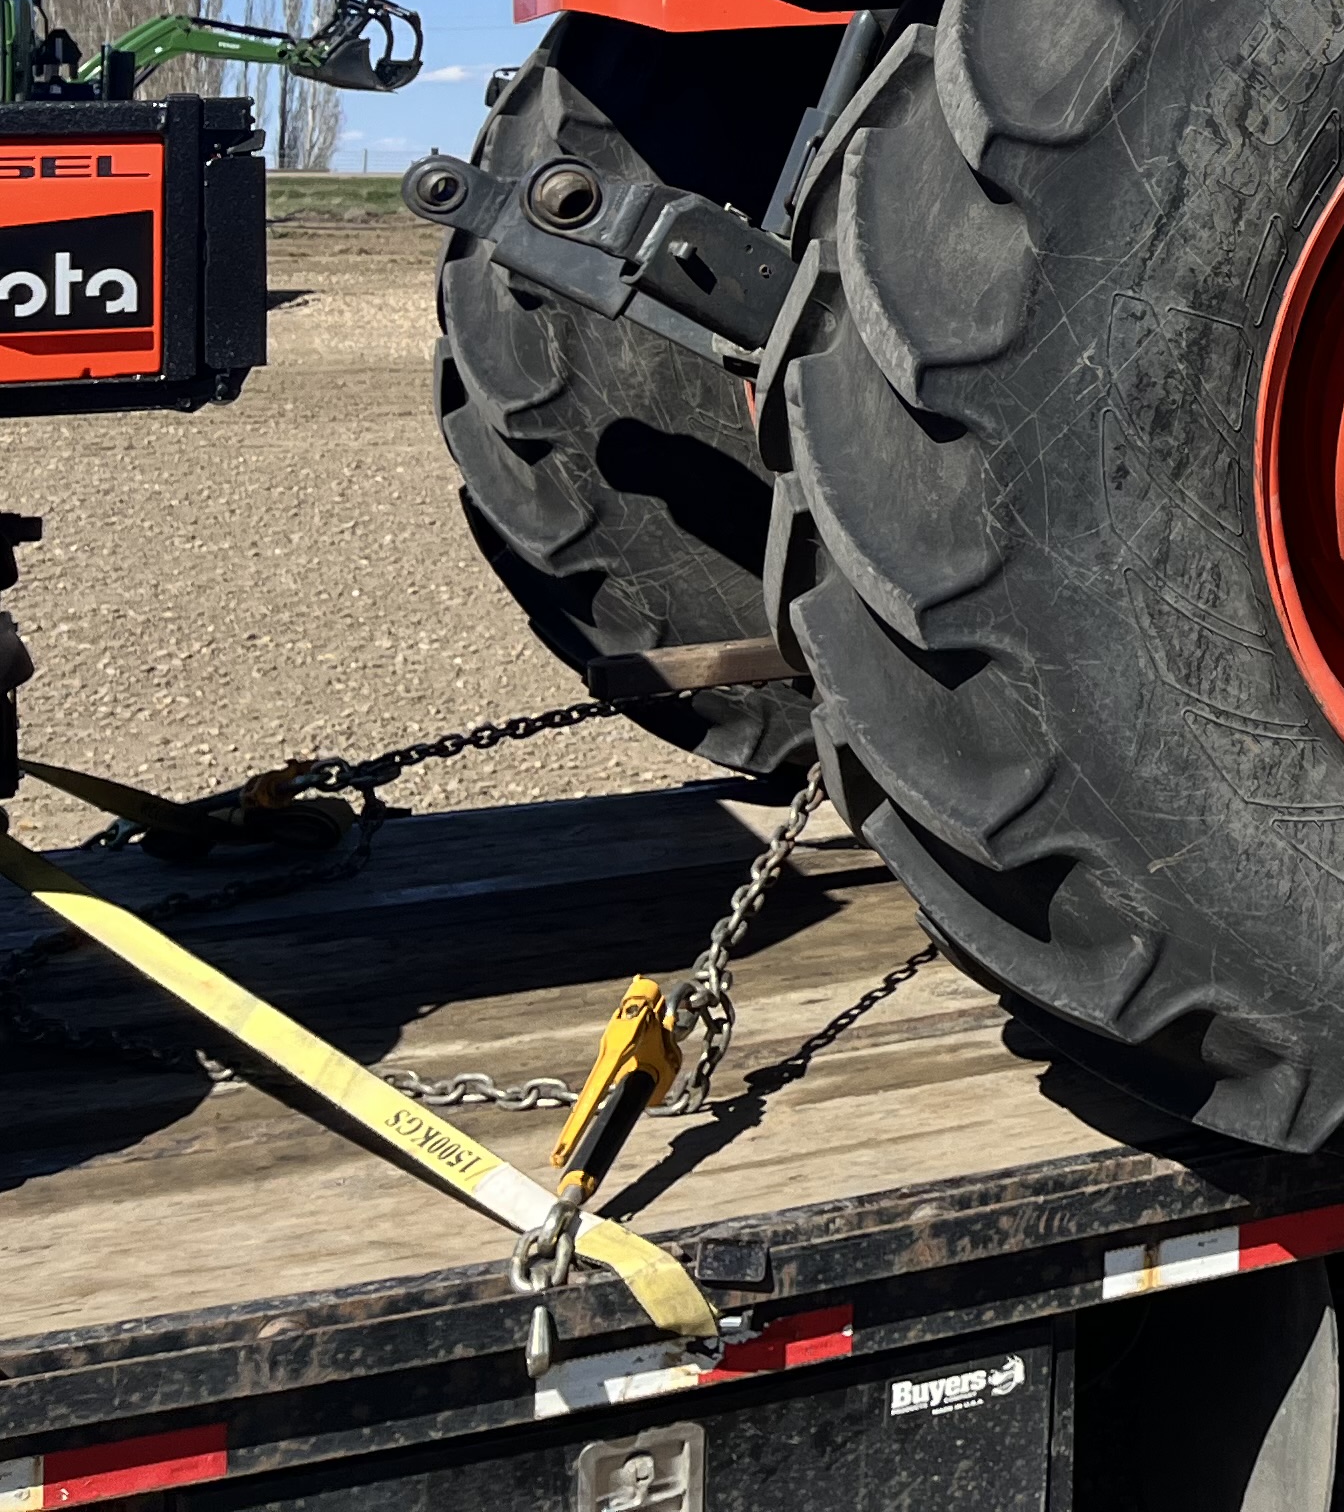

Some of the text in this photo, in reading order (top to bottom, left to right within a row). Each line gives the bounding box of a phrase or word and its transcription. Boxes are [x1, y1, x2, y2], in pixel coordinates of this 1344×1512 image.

[0, 251, 139, 318] ota
[384, 1108, 482, 1173] 1500KGS
[891, 1369, 987, 1408] Buyers
